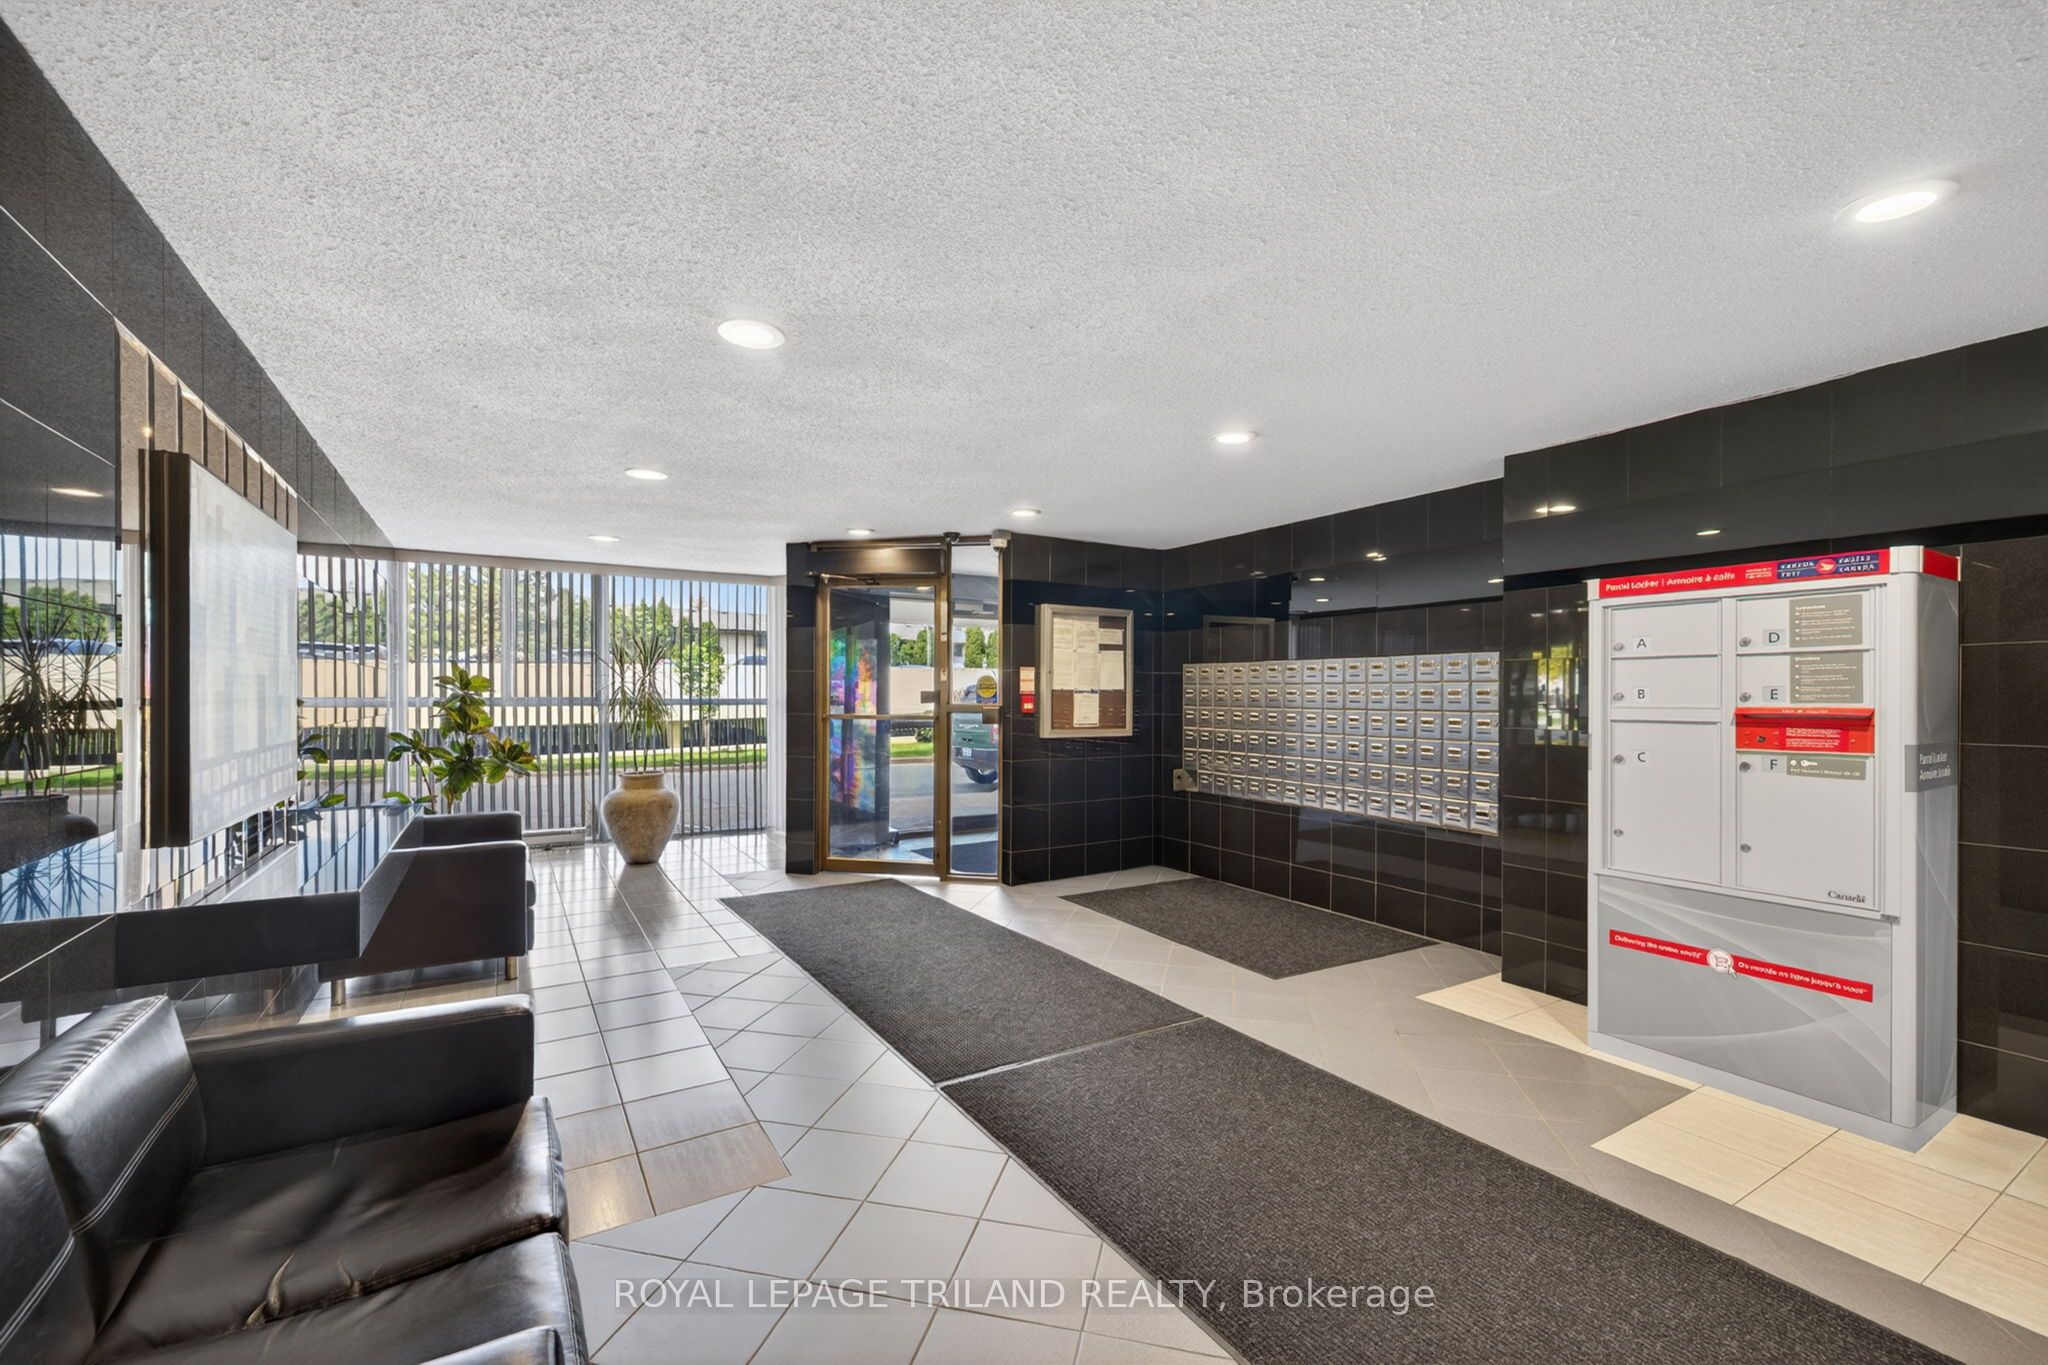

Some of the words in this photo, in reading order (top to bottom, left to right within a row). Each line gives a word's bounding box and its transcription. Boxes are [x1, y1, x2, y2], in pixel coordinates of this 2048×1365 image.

[1636, 638, 1647, 649] A
[1768, 631, 1780, 644] D
[1637, 688, 1646, 700] B
[1770, 688, 1779, 700] E
[1637, 751, 1646, 763] C
[1769, 759, 1778, 770] F
